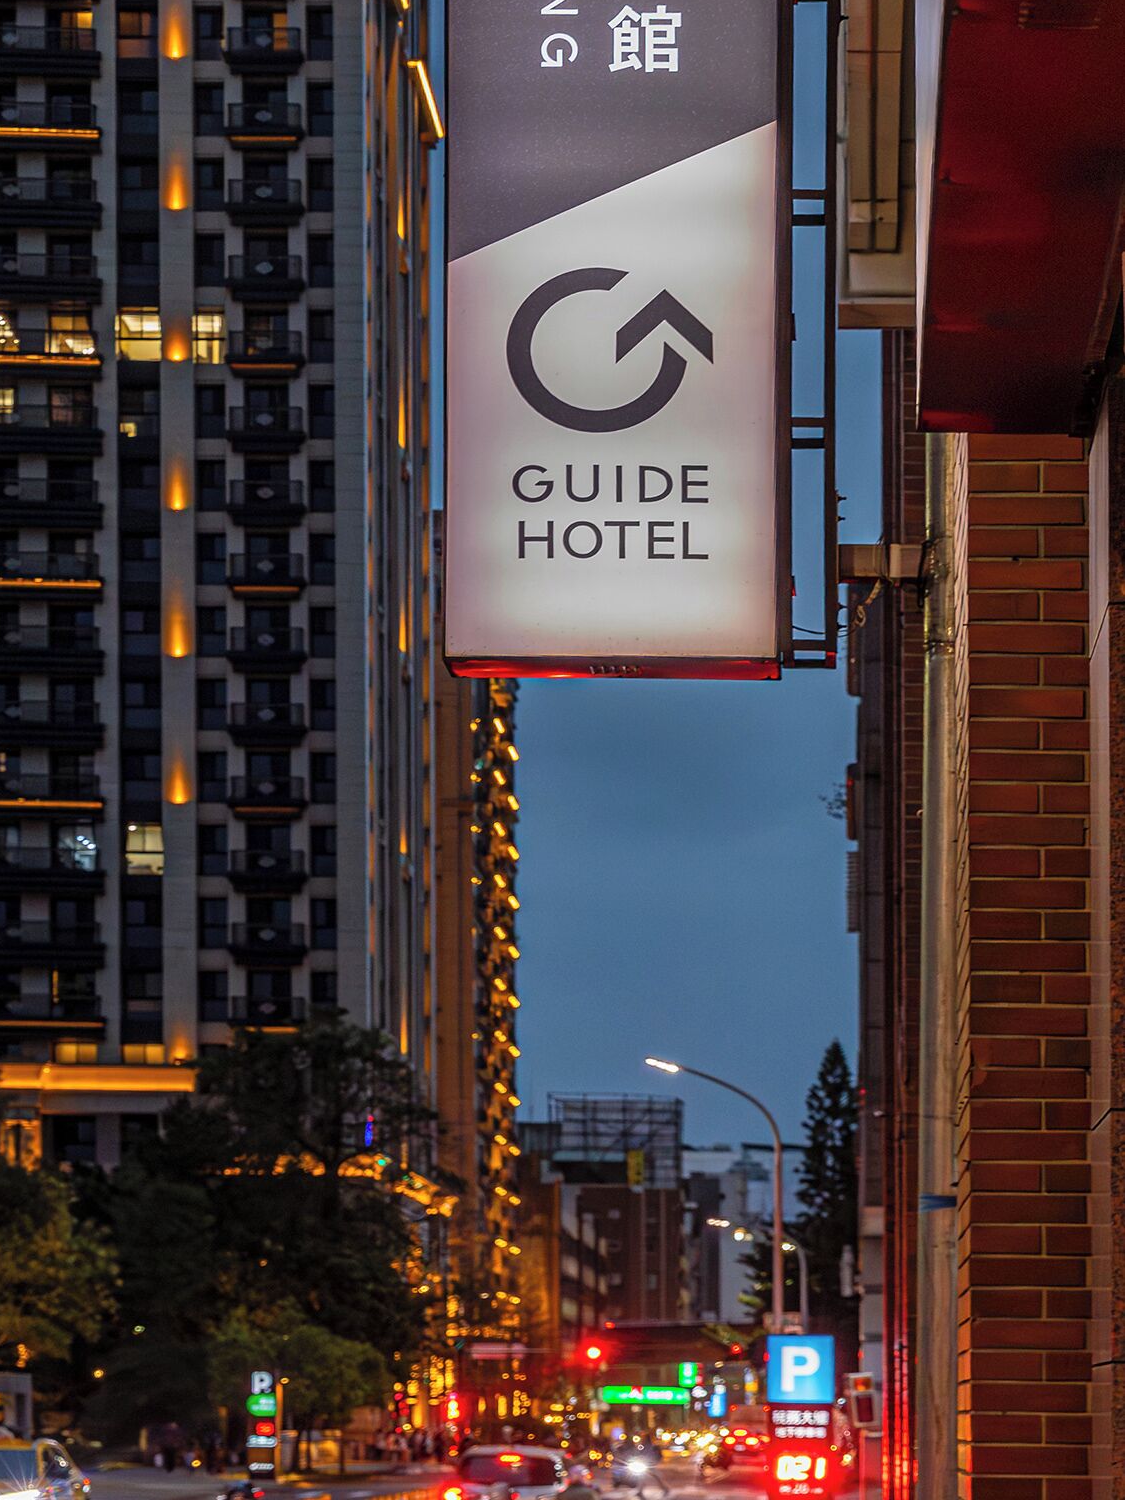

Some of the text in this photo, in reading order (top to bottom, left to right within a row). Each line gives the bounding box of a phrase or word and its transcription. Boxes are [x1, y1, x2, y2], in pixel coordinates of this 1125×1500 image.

[512, 464, 709, 504] GUIDE
[518, 520, 709, 560] HOTEL
[781, 1346, 820, 1392] P
